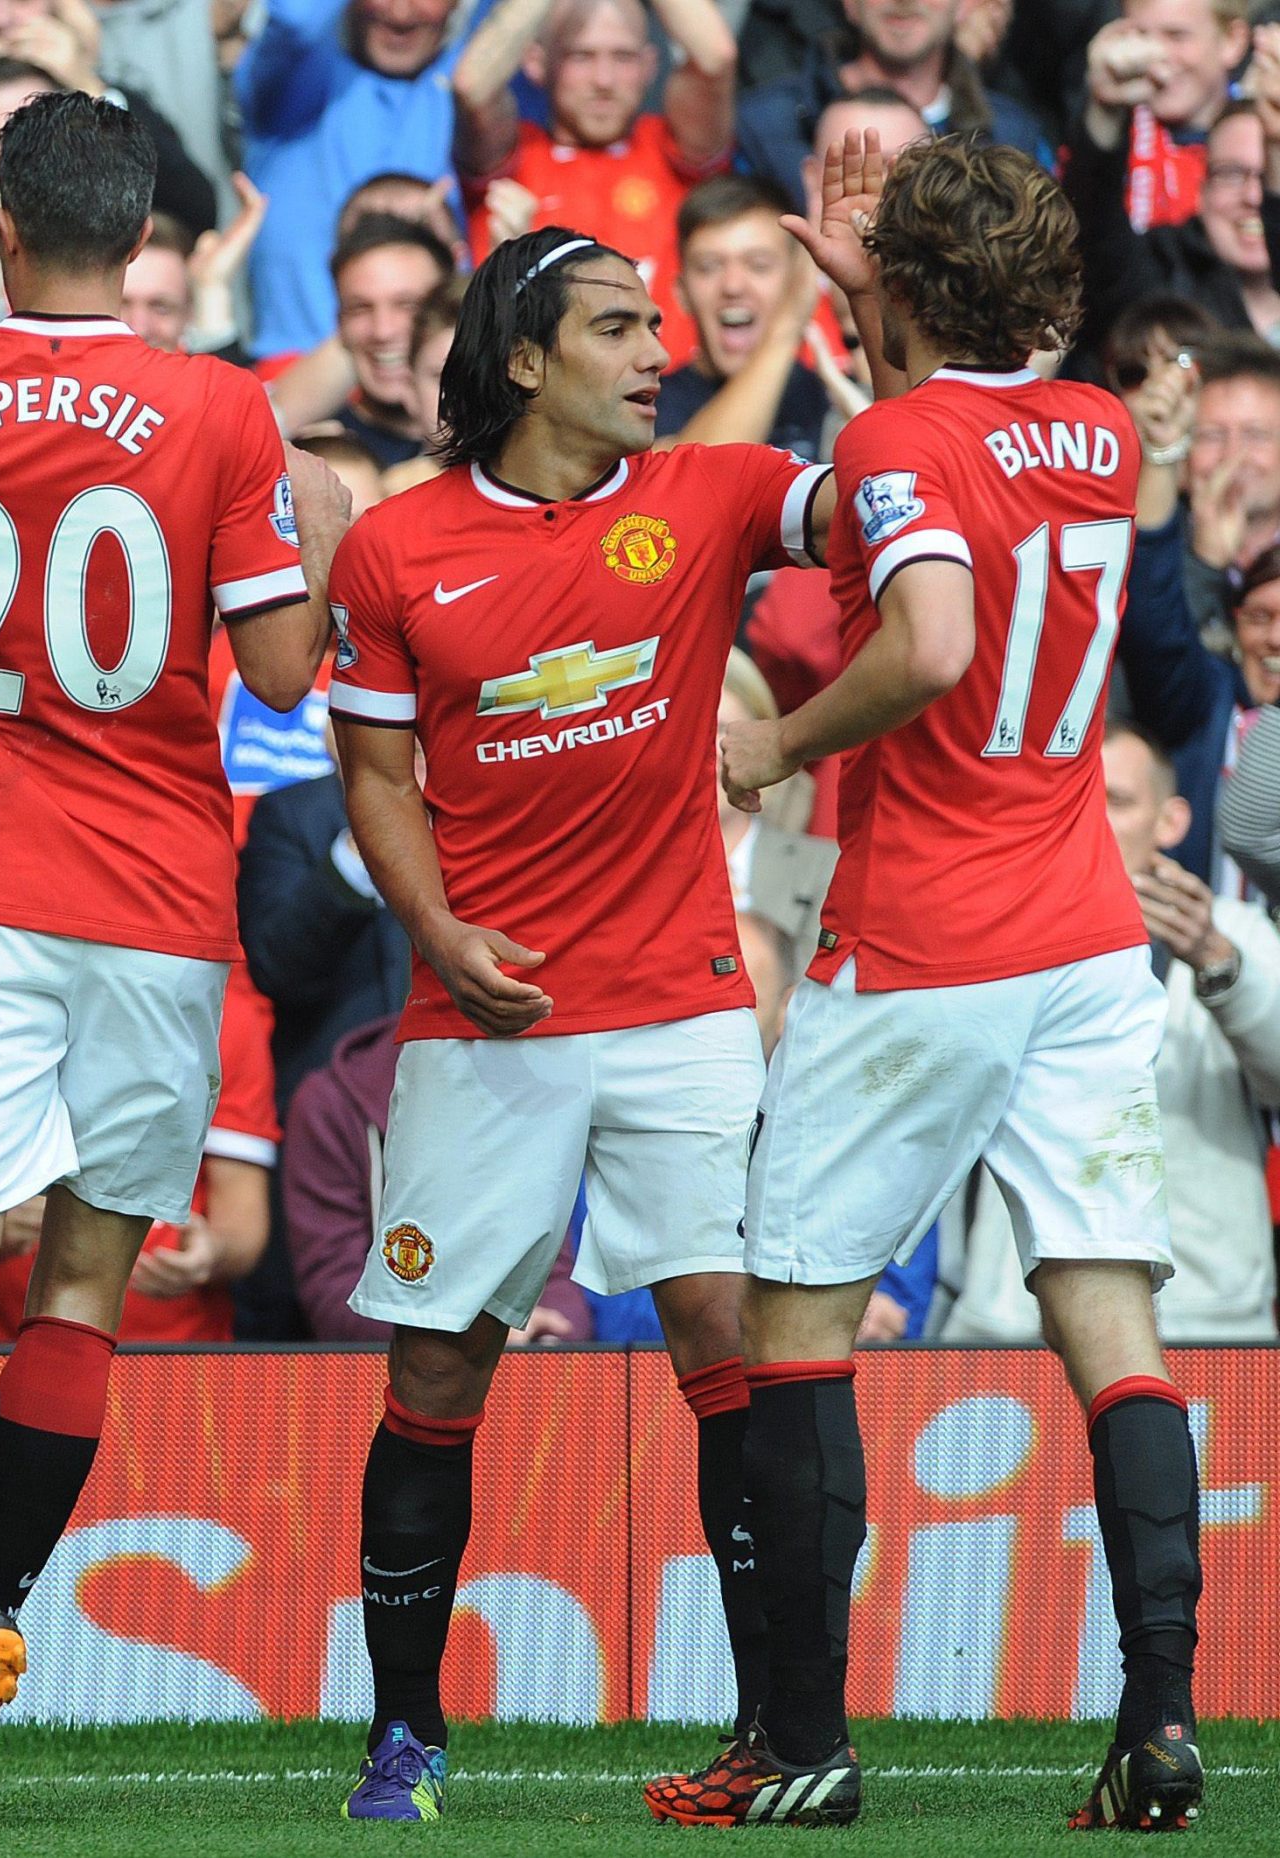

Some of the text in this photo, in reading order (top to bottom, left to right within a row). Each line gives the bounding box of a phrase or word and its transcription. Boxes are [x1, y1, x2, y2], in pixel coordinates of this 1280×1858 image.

[984, 421, 1120, 478] BLIND
[981, 517, 1133, 757] 17
[476, 697, 670, 763] CHEVROLET
[363, 1586, 441, 1606] MUFC
